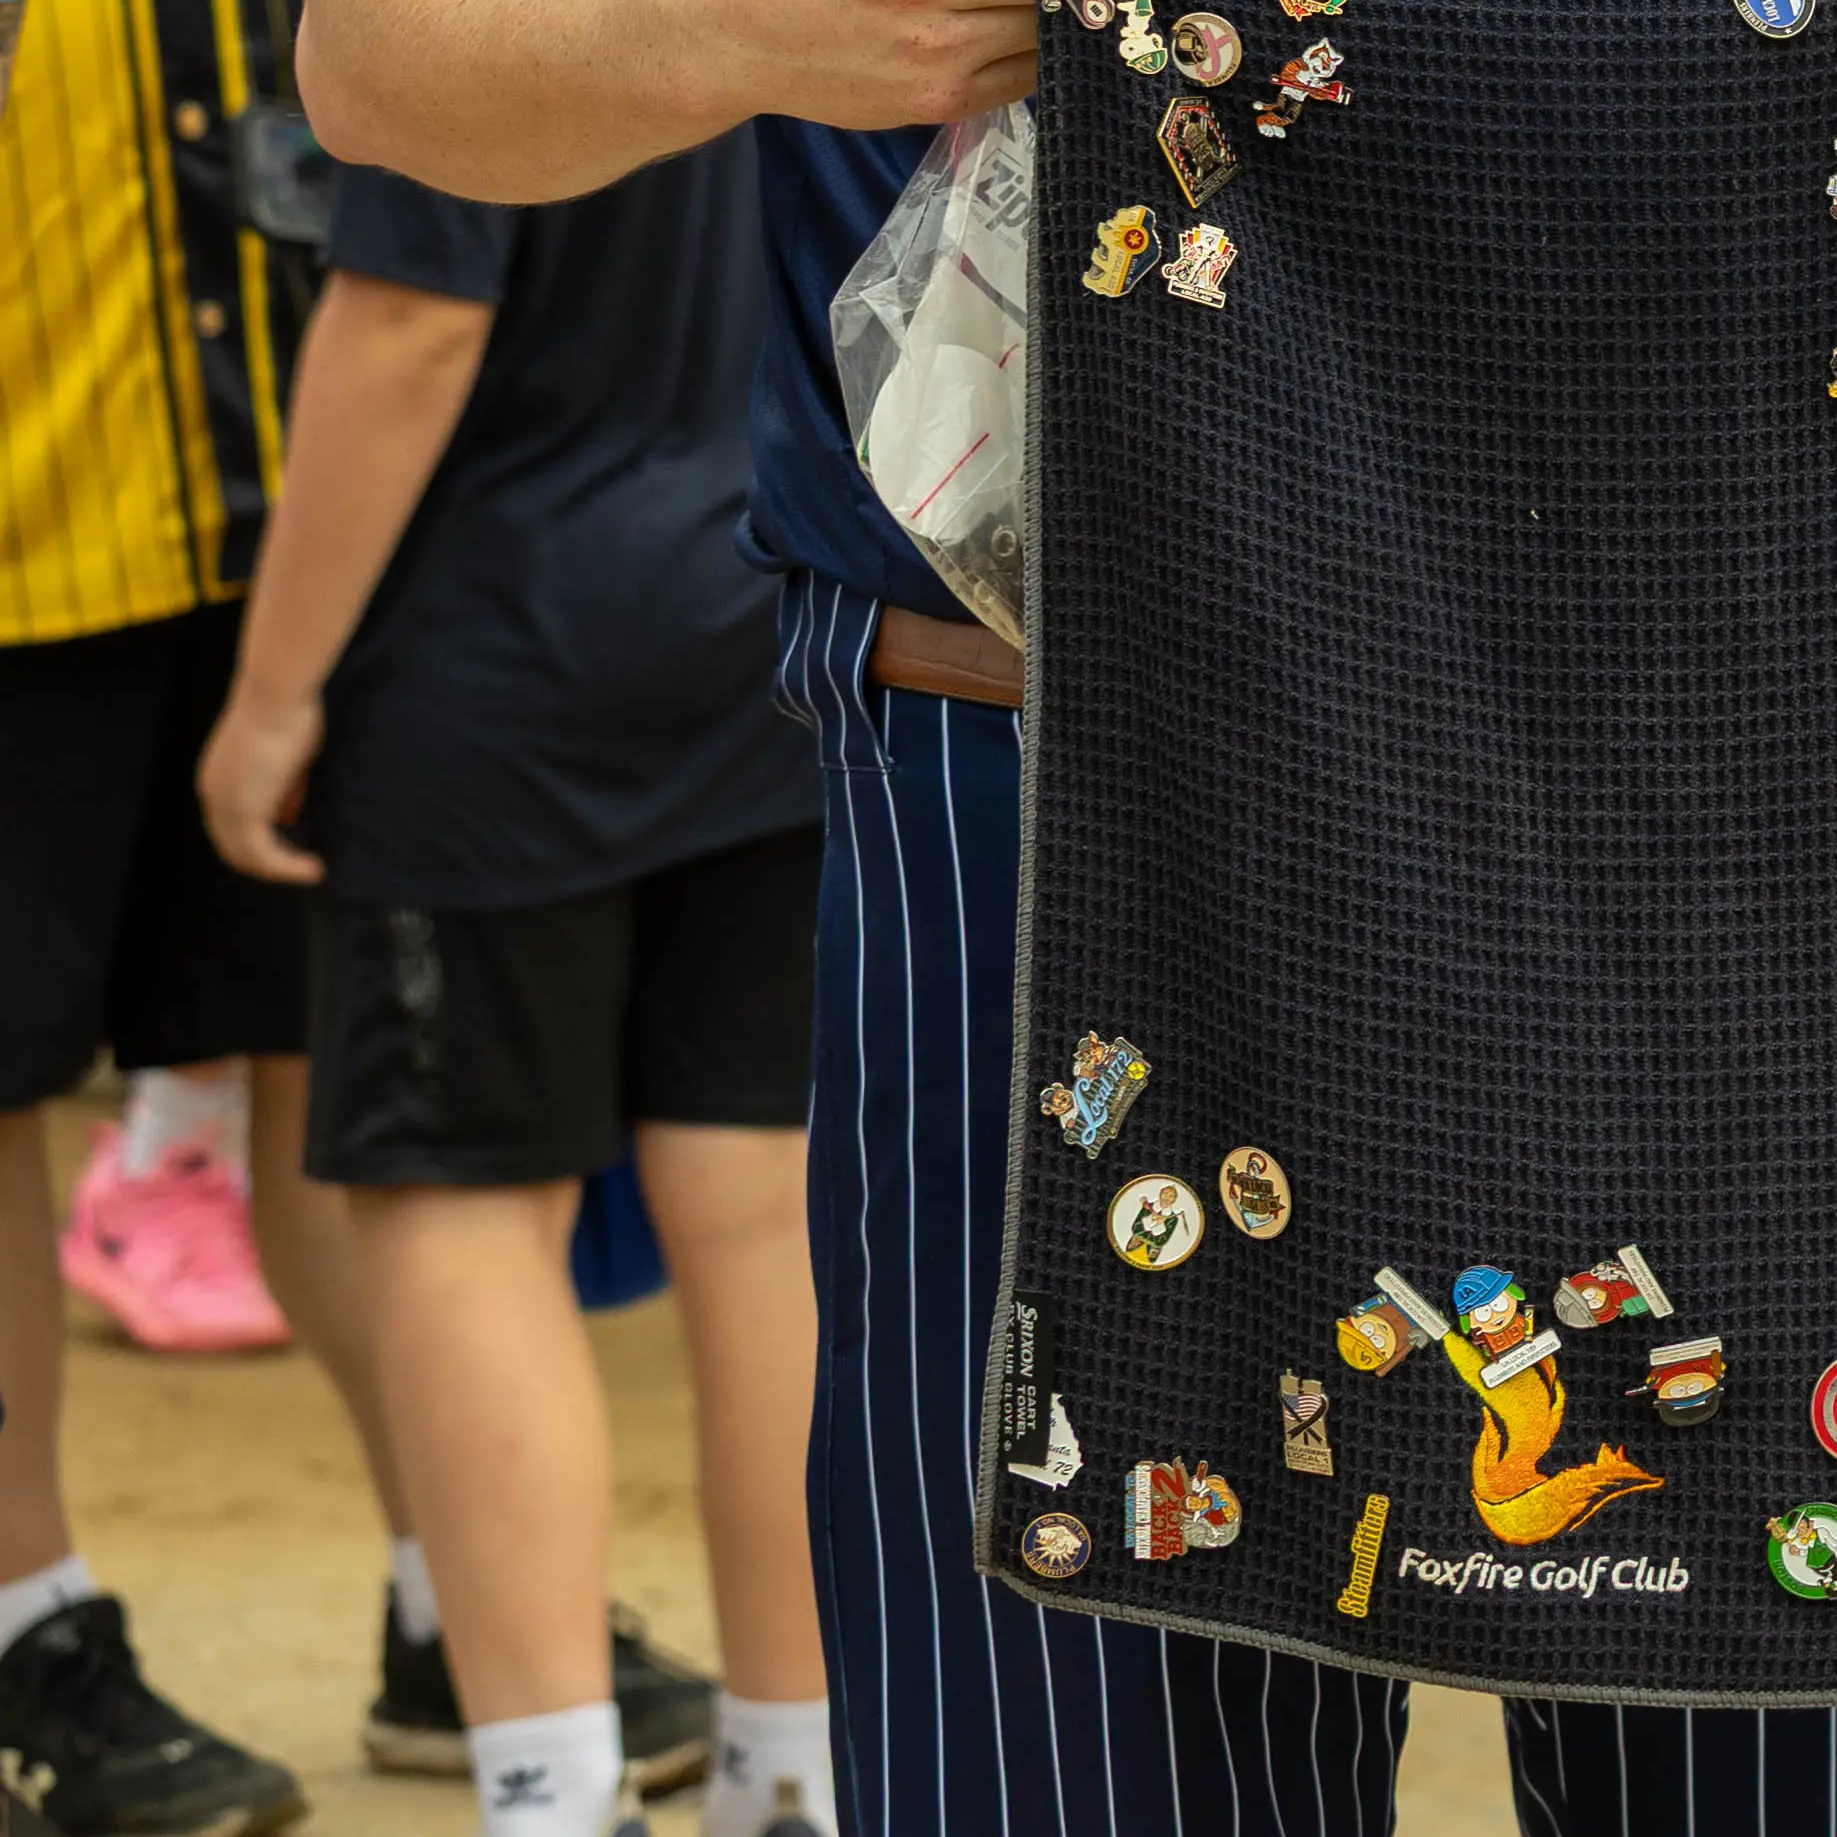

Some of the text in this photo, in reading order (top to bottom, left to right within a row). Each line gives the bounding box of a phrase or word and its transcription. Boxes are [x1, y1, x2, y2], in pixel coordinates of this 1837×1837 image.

[1074, 1051, 1132, 1146] Local 172
[1016, 1302, 1038, 1378] SRIXON
[1016, 1386, 1027, 1441] TOWEL
[1028, 1386, 1037, 1431] CART
[1151, 1462, 1184, 1558] BACK 2
[1166, 1496, 1182, 1553] BACK
[1338, 1493, 1390, 1618] Steamfitters
[1399, 1548, 1689, 1598] Foxfire Golf Club
